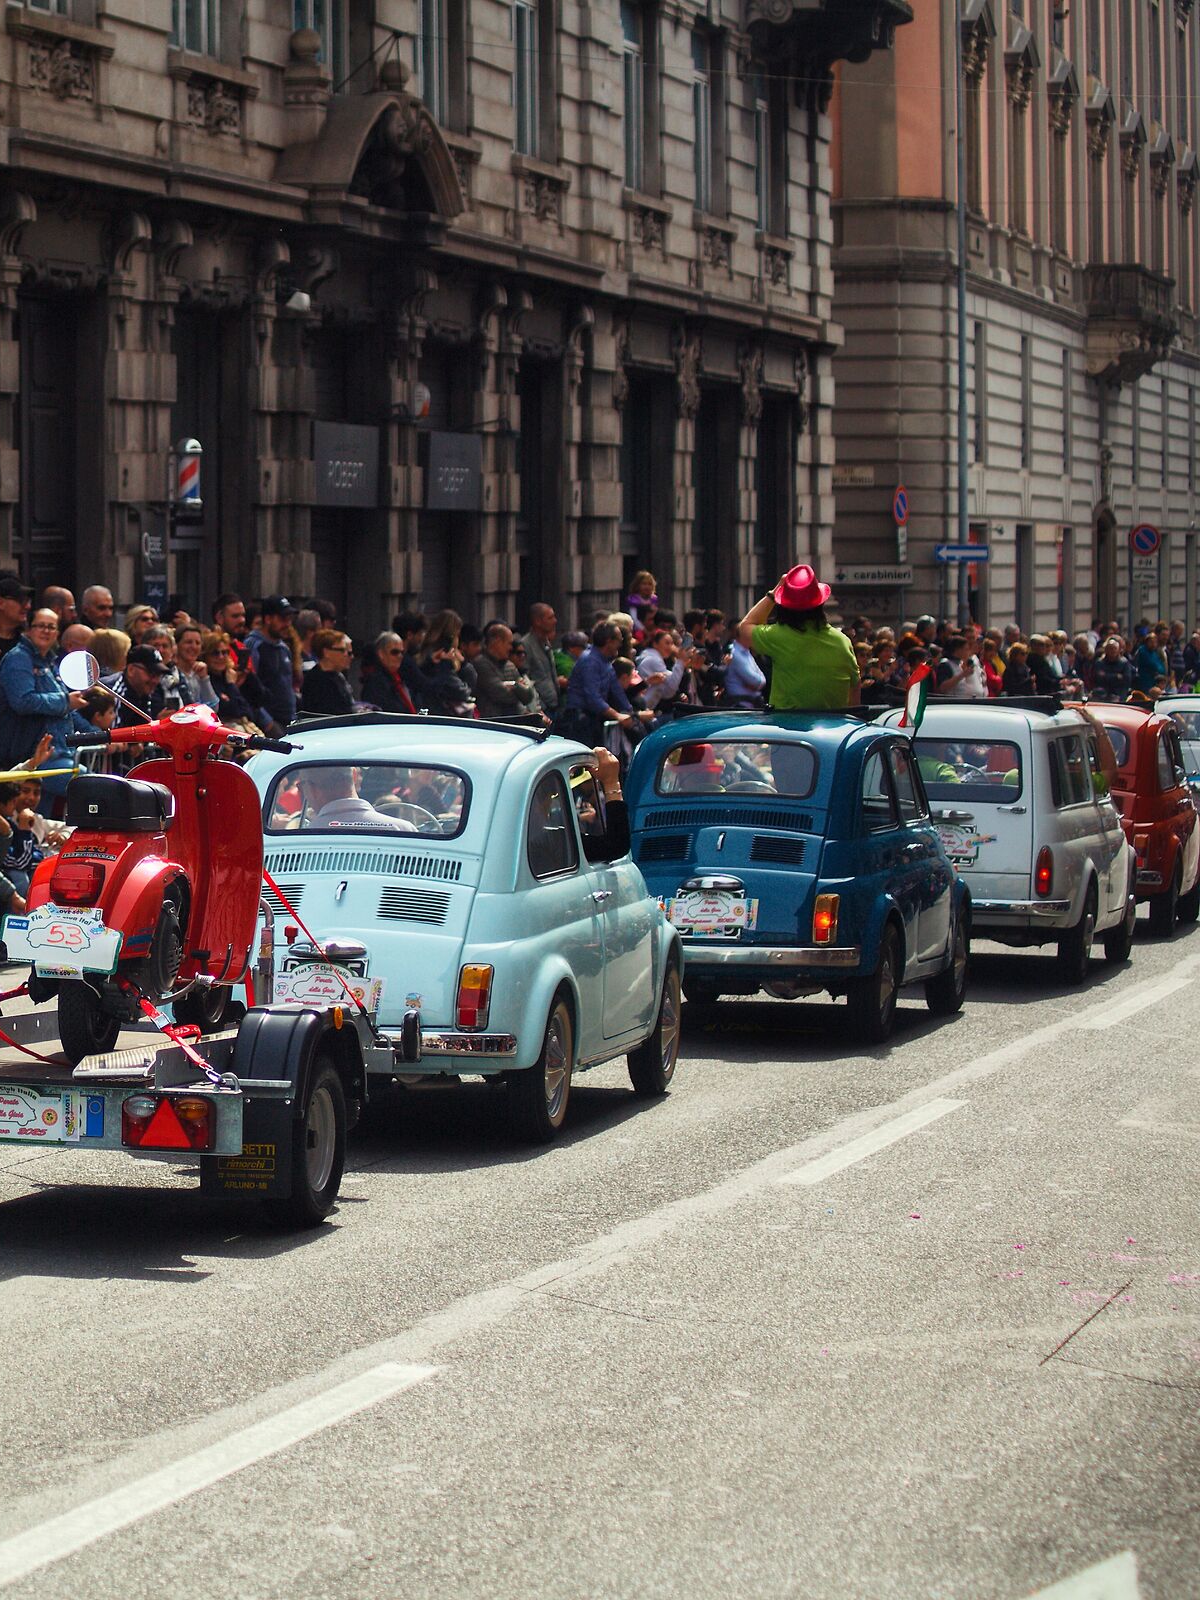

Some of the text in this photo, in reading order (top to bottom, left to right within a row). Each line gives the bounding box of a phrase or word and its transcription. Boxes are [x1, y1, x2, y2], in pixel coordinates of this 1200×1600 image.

[854, 569, 911, 580] carabinieri
[47, 925, 83, 945] 53
[18, 1088, 37, 1100] Italia
[17, 1128, 48, 1136] 2025
[227, 1159, 266, 1169] rimorchi
